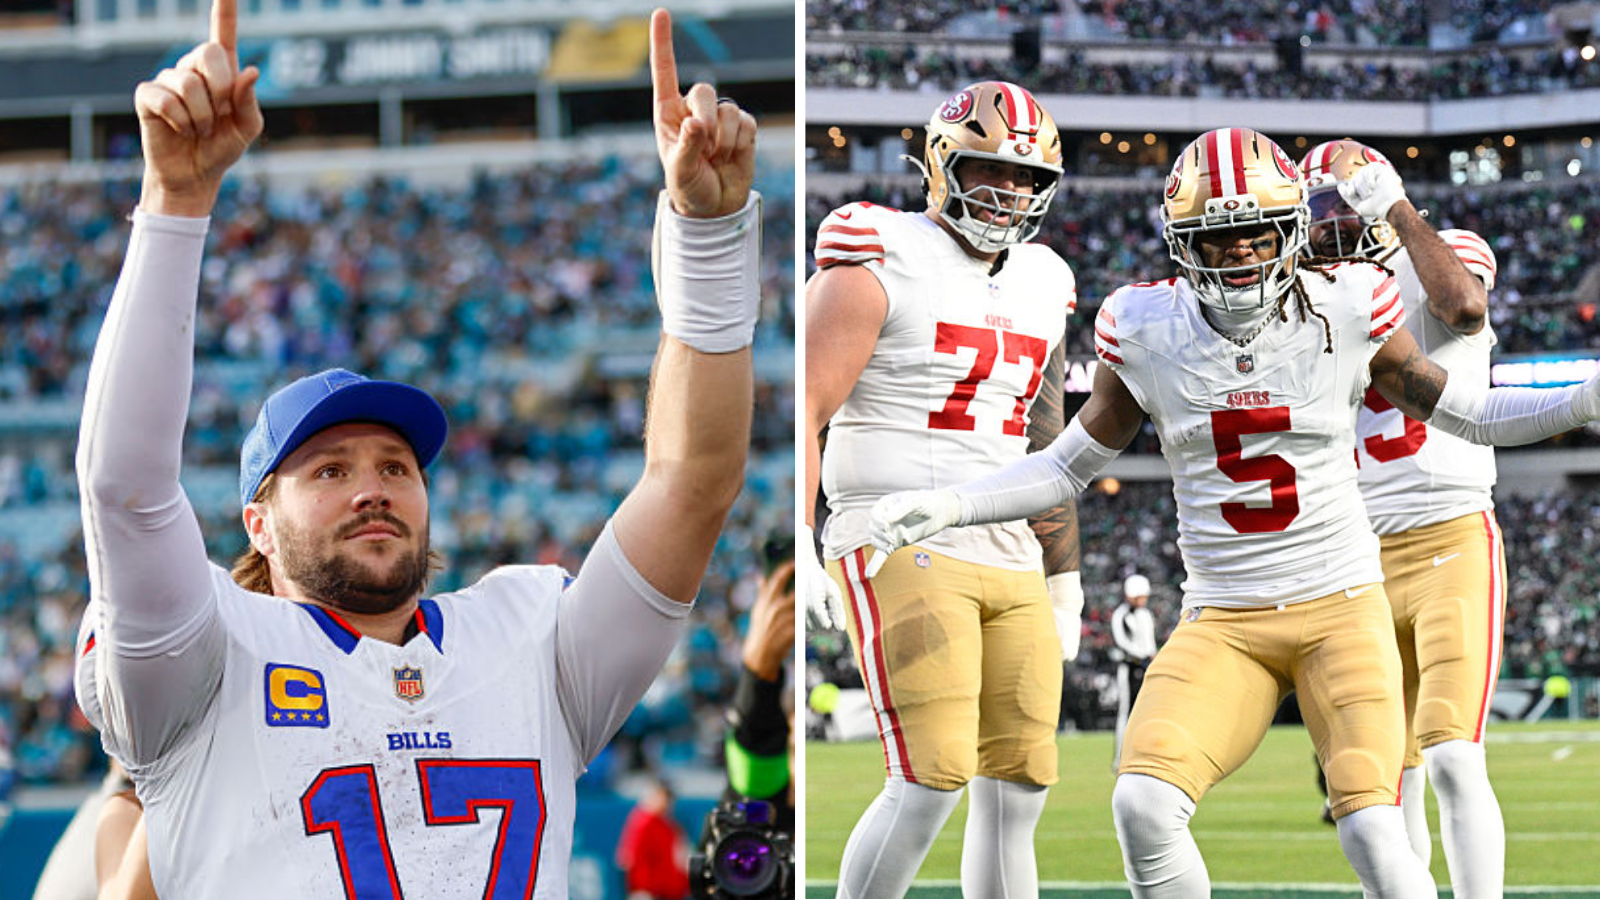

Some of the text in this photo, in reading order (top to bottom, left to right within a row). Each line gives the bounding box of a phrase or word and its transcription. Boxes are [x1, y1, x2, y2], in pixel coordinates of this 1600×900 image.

[450, 29, 550, 77] SMITH
[928, 321, 1048, 437] 77
[1226, 390, 1271, 408] 49ERS
[1211, 406, 1299, 533] 5
[270, 667, 323, 711] C
[398, 681, 423, 696] NFL
[386, 732, 452, 750] BILLS
[300, 758, 547, 898] 17
